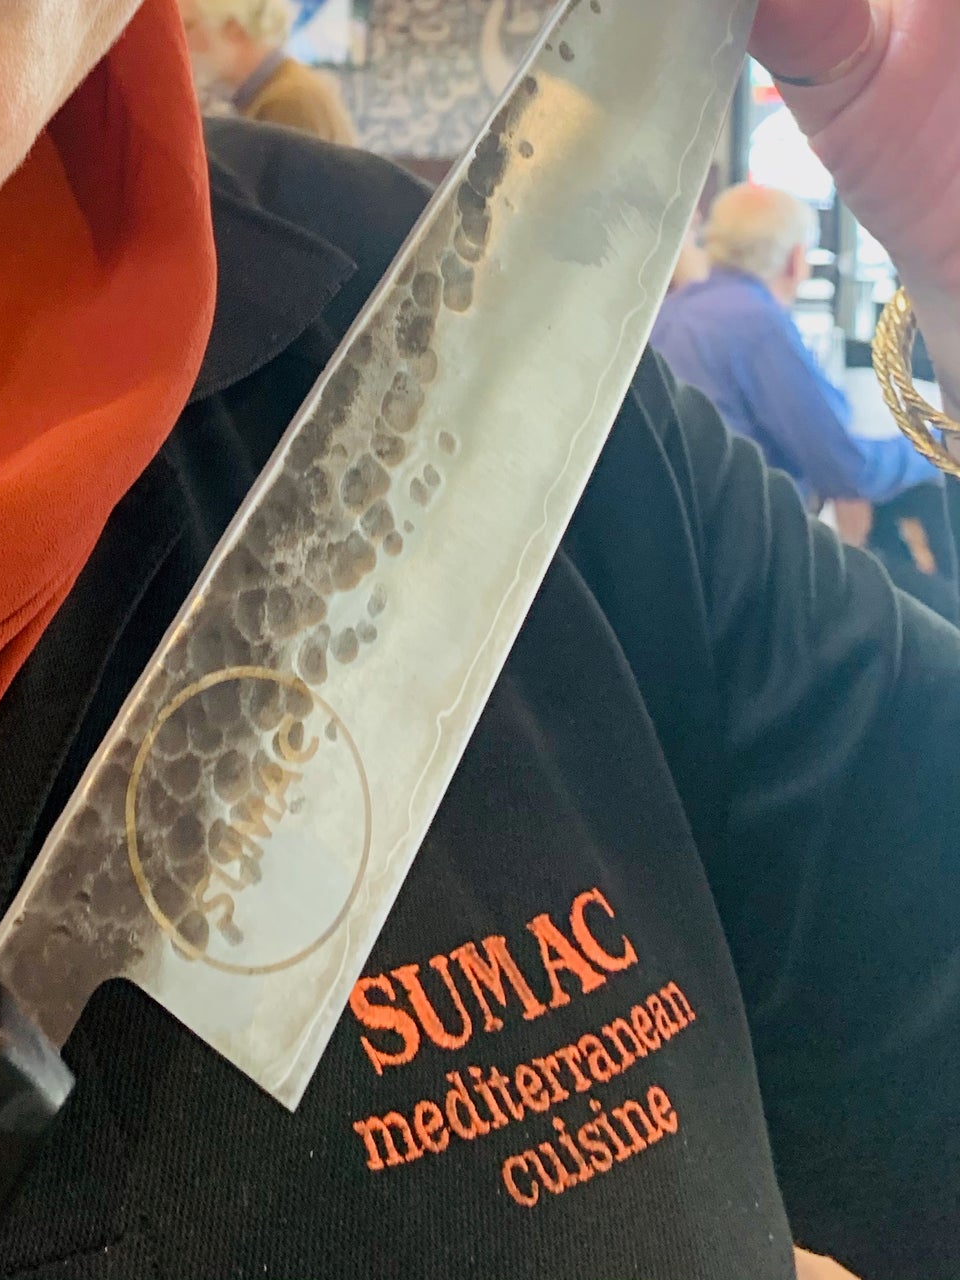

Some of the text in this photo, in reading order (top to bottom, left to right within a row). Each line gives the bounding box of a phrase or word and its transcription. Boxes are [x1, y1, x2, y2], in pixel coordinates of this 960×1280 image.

[195, 713, 320, 930] SUMAC
[349, 887, 638, 1076] SUMAC
[353, 980, 696, 1170] mediterranean
[501, 1085, 679, 1207] cuisine
